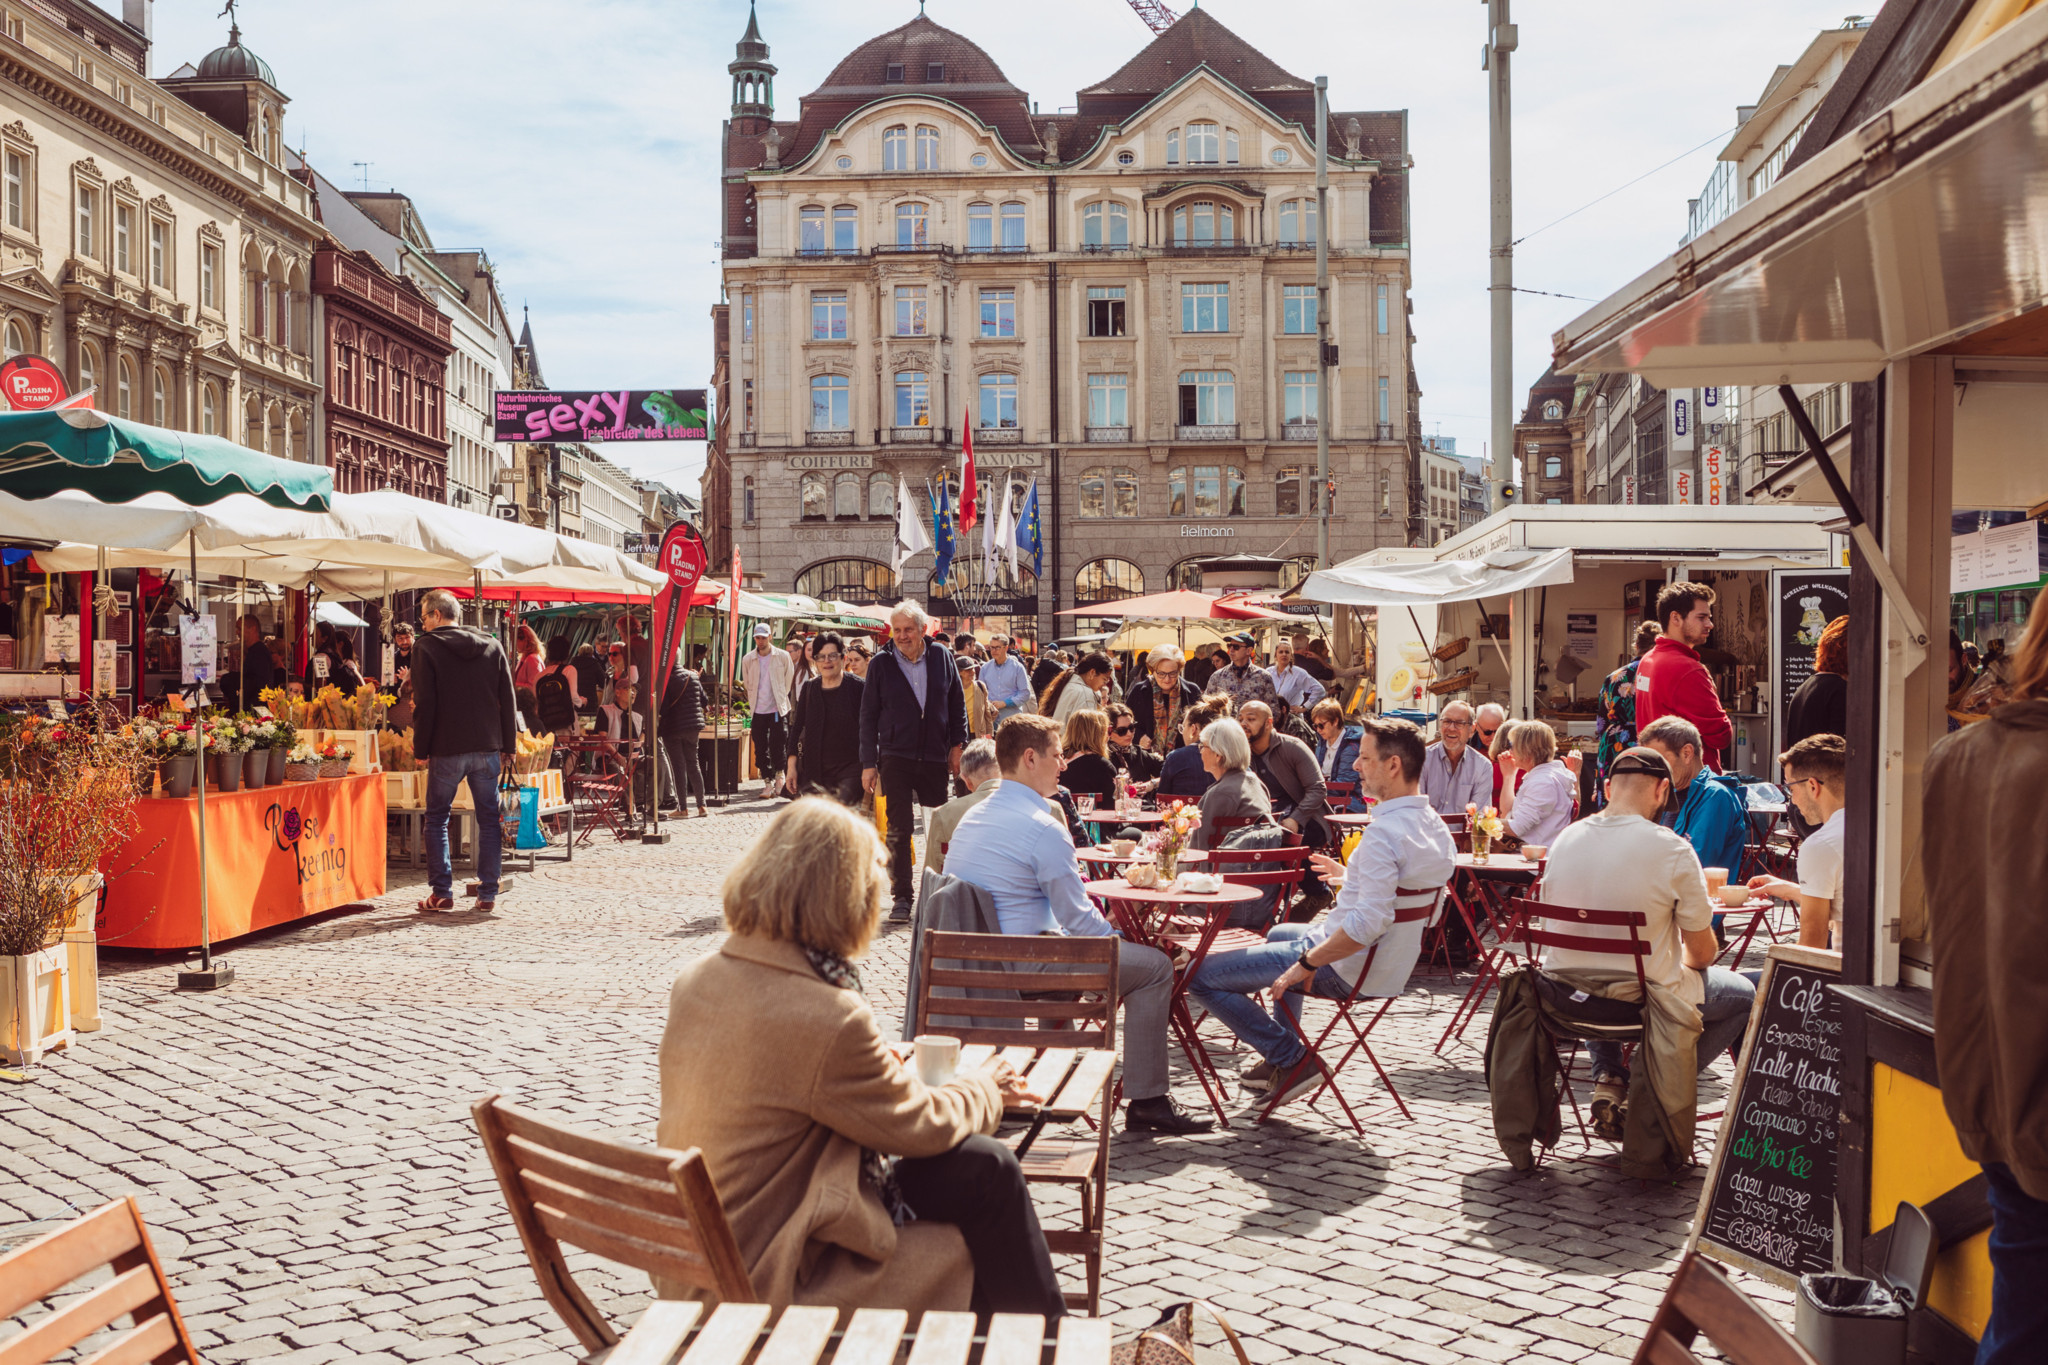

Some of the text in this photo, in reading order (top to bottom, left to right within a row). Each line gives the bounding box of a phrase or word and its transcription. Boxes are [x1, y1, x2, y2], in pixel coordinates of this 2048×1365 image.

[12, 376, 53, 394] PIADINA
[497, 394, 562, 403] Naturhistorisches
[497, 403, 527, 412] Museum
[497, 411, 517, 420] Basel
[525, 391, 630, 441] sexy
[1676, 402, 1685, 433] Berlitz
[644, 425, 664, 439] des
[667, 424, 706, 438] Lebens
[790, 456, 870, 468] COIFFURE
[1706, 447, 1722, 475] city
[1677, 472, 1690, 496] city
[1709, 477, 1722, 505] oop
[497, 508, 516, 520] P
[624, 544, 659, 553] Jeff Wa
[671, 543, 696, 572] PIADINA
[674, 568, 693, 580] STAND
[1811, 583, 1849, 600] WILLKOMMEN
[1765, 1023, 1818, 1057] Espresso
[1753, 1136, 1784, 1172] Bio
[1787, 1144, 1813, 1179] Tee
[1729, 1167, 1811, 1211] dazu unsere
[1727, 1217, 1799, 1267] GEBÄCKE
